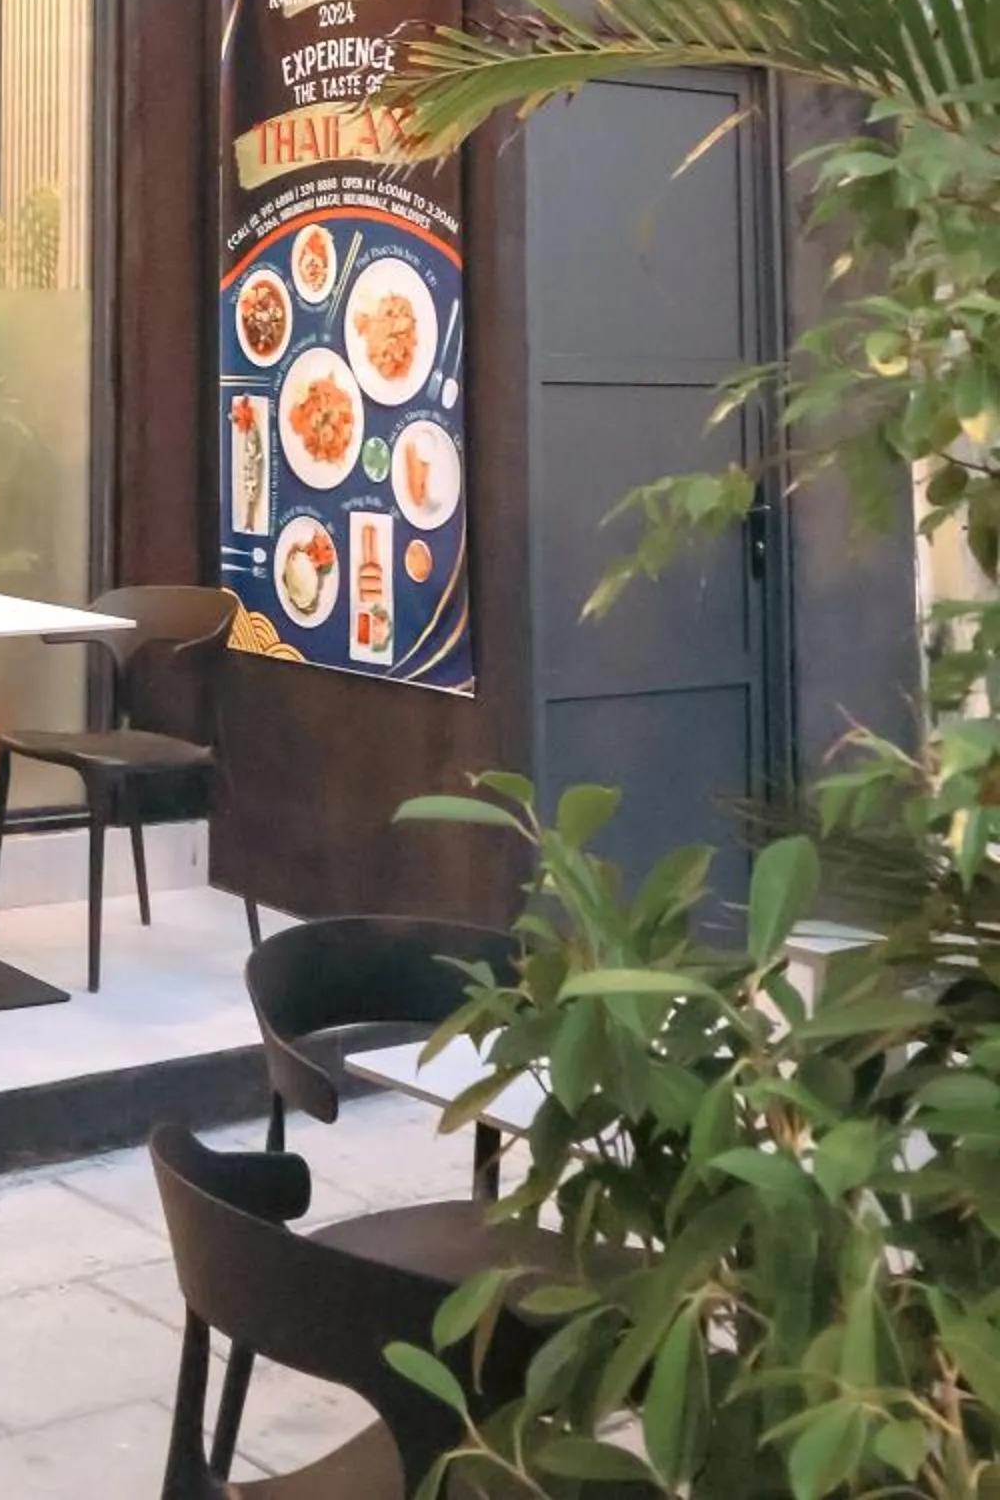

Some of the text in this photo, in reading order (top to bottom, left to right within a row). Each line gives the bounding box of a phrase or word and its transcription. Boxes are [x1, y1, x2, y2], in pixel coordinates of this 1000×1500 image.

[319, 2, 356, 27] 2024
[281, 37, 395, 86] EXPERIENCE
[294, 81, 317, 105] THE
[322, 74, 361, 99] TASTE
[253, 106, 412, 168] THAILA
[341, 177, 363, 189] OPEN
[365, 179, 376, 191] AT
[413, 193, 426, 210] TO
